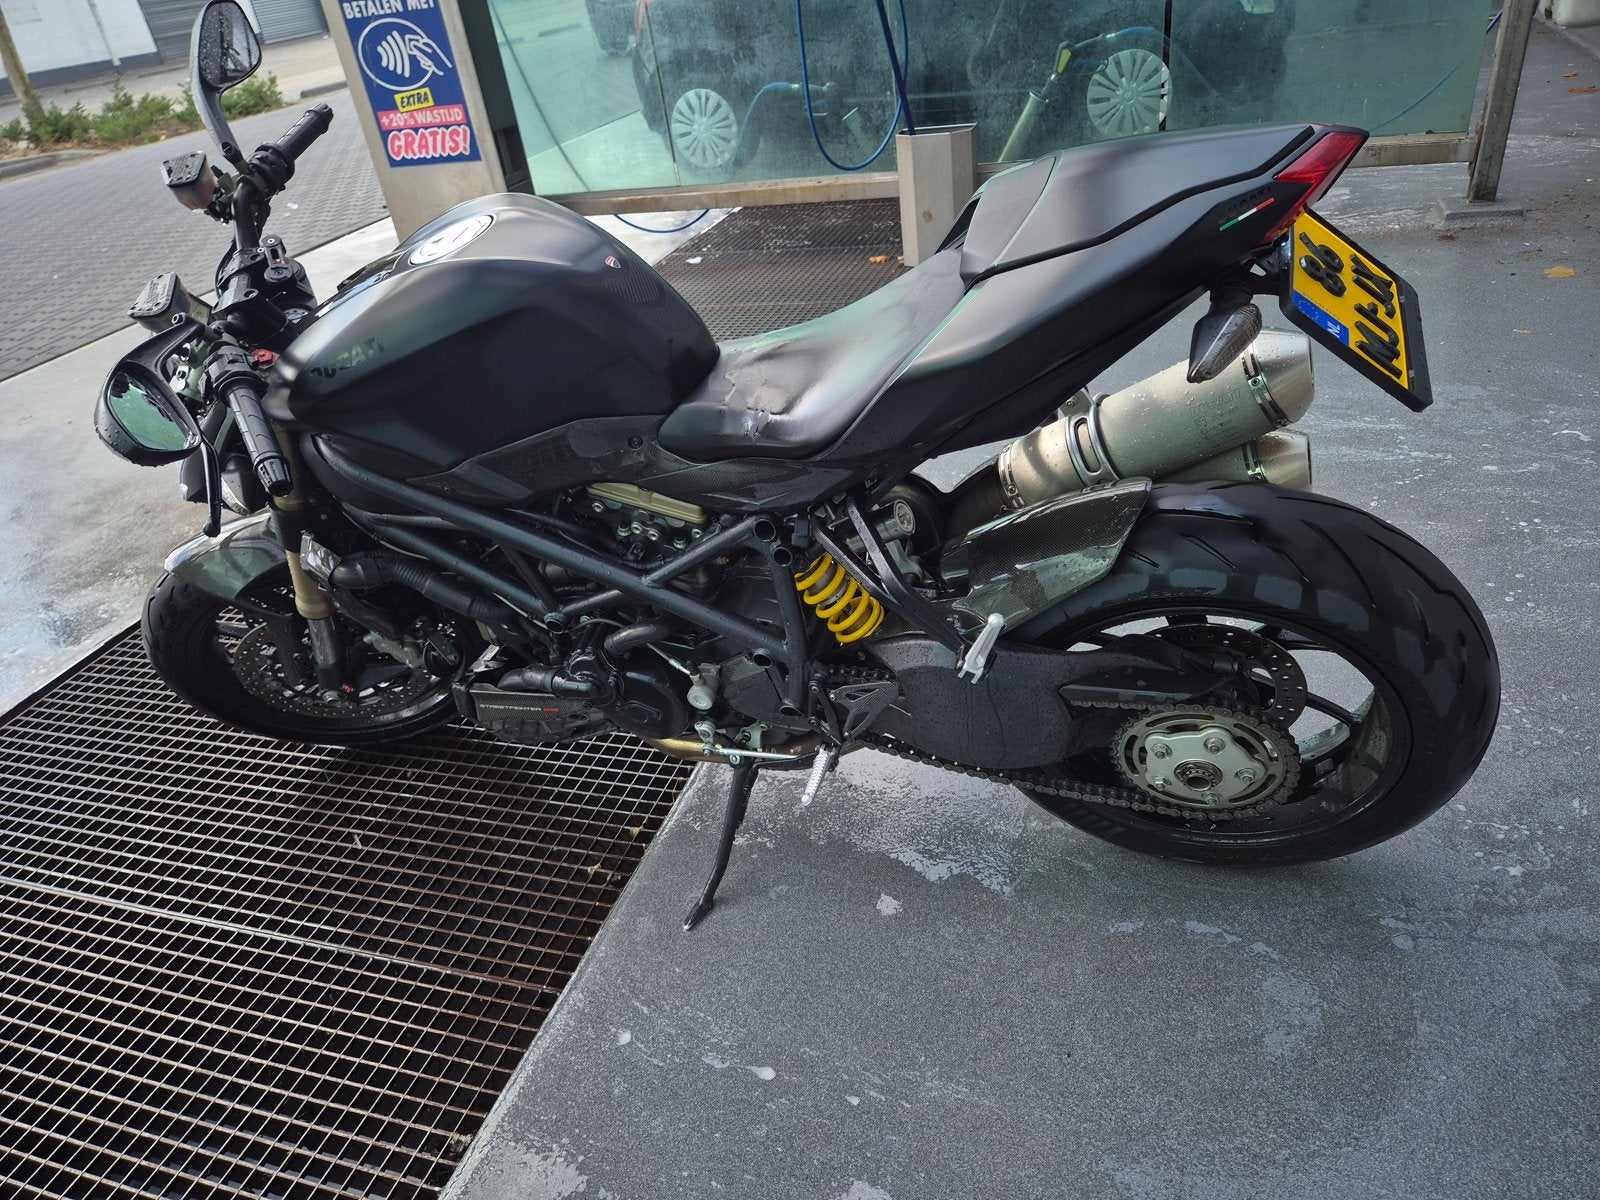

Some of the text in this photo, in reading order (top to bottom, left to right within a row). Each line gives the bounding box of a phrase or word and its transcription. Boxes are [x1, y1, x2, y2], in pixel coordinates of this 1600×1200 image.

[342, 0, 404, 19] BETALEN
[400, 91, 430, 109] EXTRA
[381, 107, 463, 127] +20% WASTIJD
[389, 126, 469, 159] GRATIS!
[1299, 231, 1347, 298] 86
[1326, 320, 1341, 339] NL
